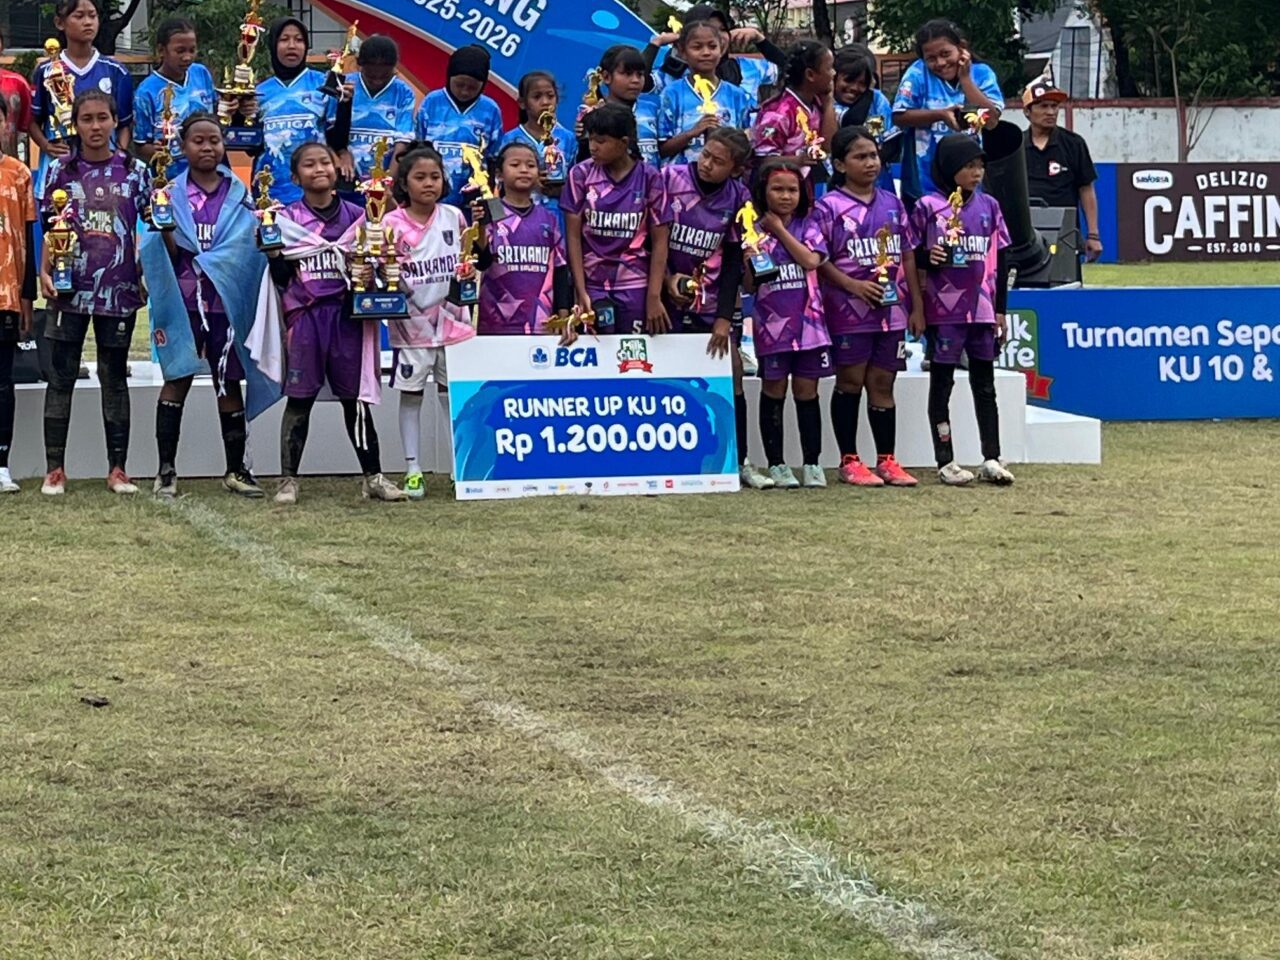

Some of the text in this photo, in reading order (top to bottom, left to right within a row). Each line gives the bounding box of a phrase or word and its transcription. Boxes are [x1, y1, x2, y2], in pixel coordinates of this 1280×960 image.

[1196, 170, 1268, 190] DELIZIO
[88, 210, 112, 223] Milk
[584, 210, 643, 232] SRIKANDI
[92, 222, 113, 234] Life
[1061, 322, 1210, 349] Turnamen
[554, 347, 598, 368] BCA
[821, 352, 831, 368] 3
[993, 341, 1035, 367] ife
[1159, 353, 1274, 382] KU 10 &
[504, 395, 686, 419] RUNNER UP KU 10
[495, 422, 699, 461] Rp 1.200.000
